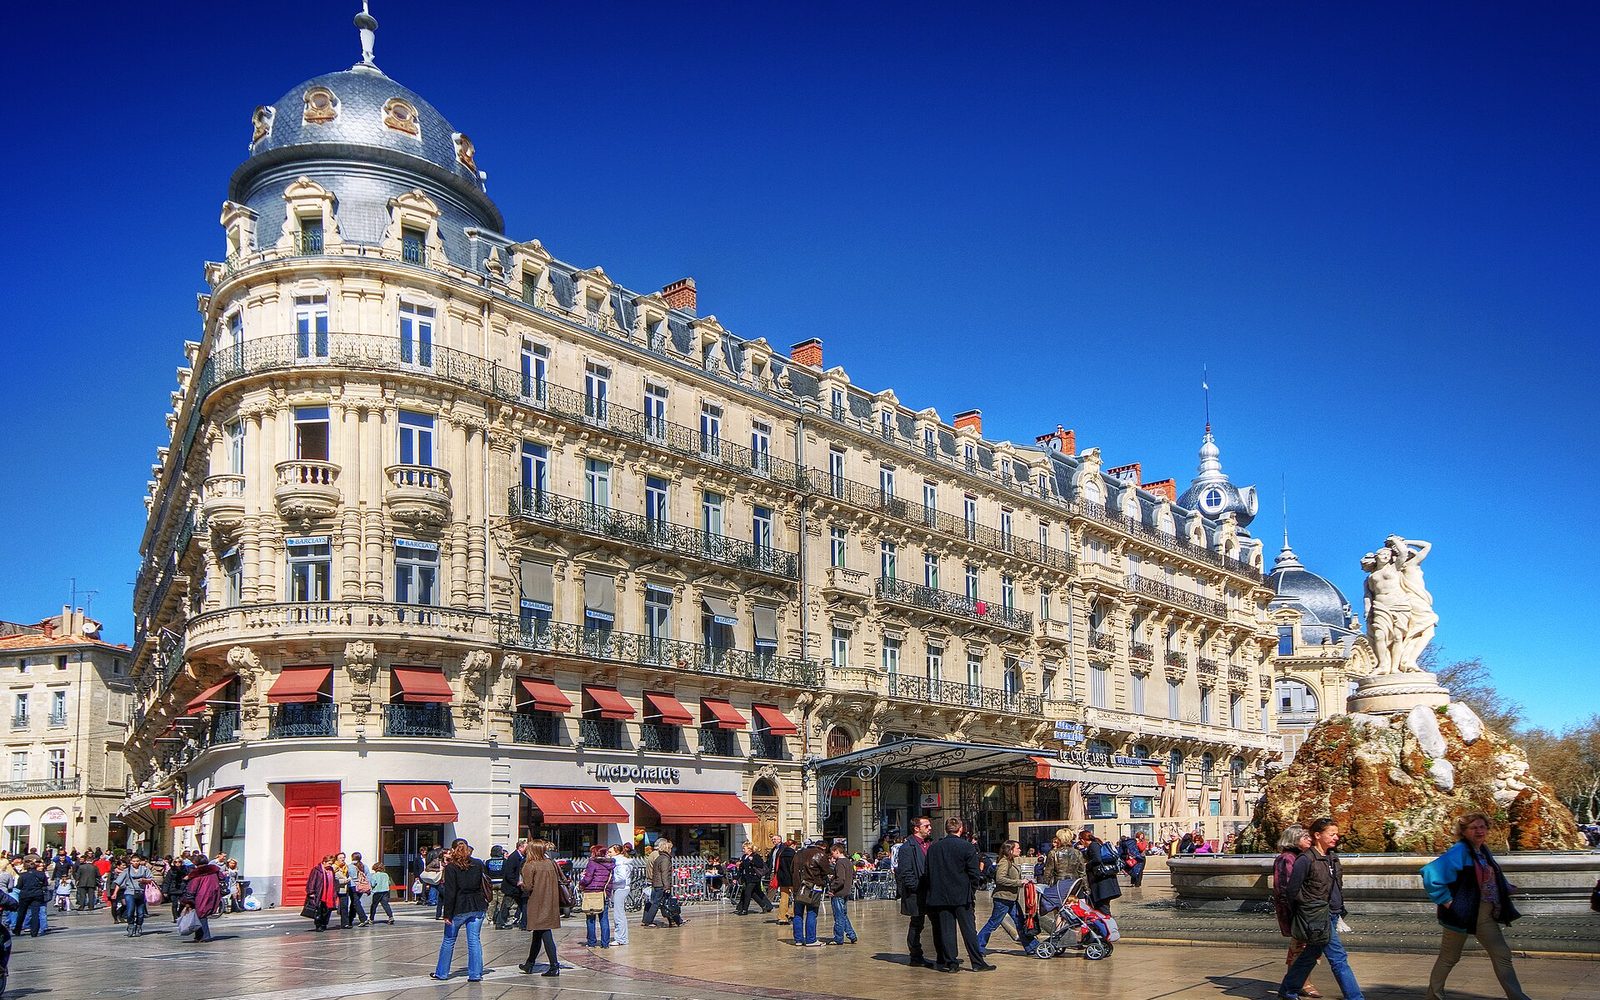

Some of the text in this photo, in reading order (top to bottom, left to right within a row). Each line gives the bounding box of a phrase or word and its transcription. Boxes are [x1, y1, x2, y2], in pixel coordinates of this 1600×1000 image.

[295, 536, 326, 545] BARCLAYS
[404, 540, 437, 551] BARCLAYS
[1092, 753, 1108, 764] 1893
[596, 764, 681, 782] McDonald's
